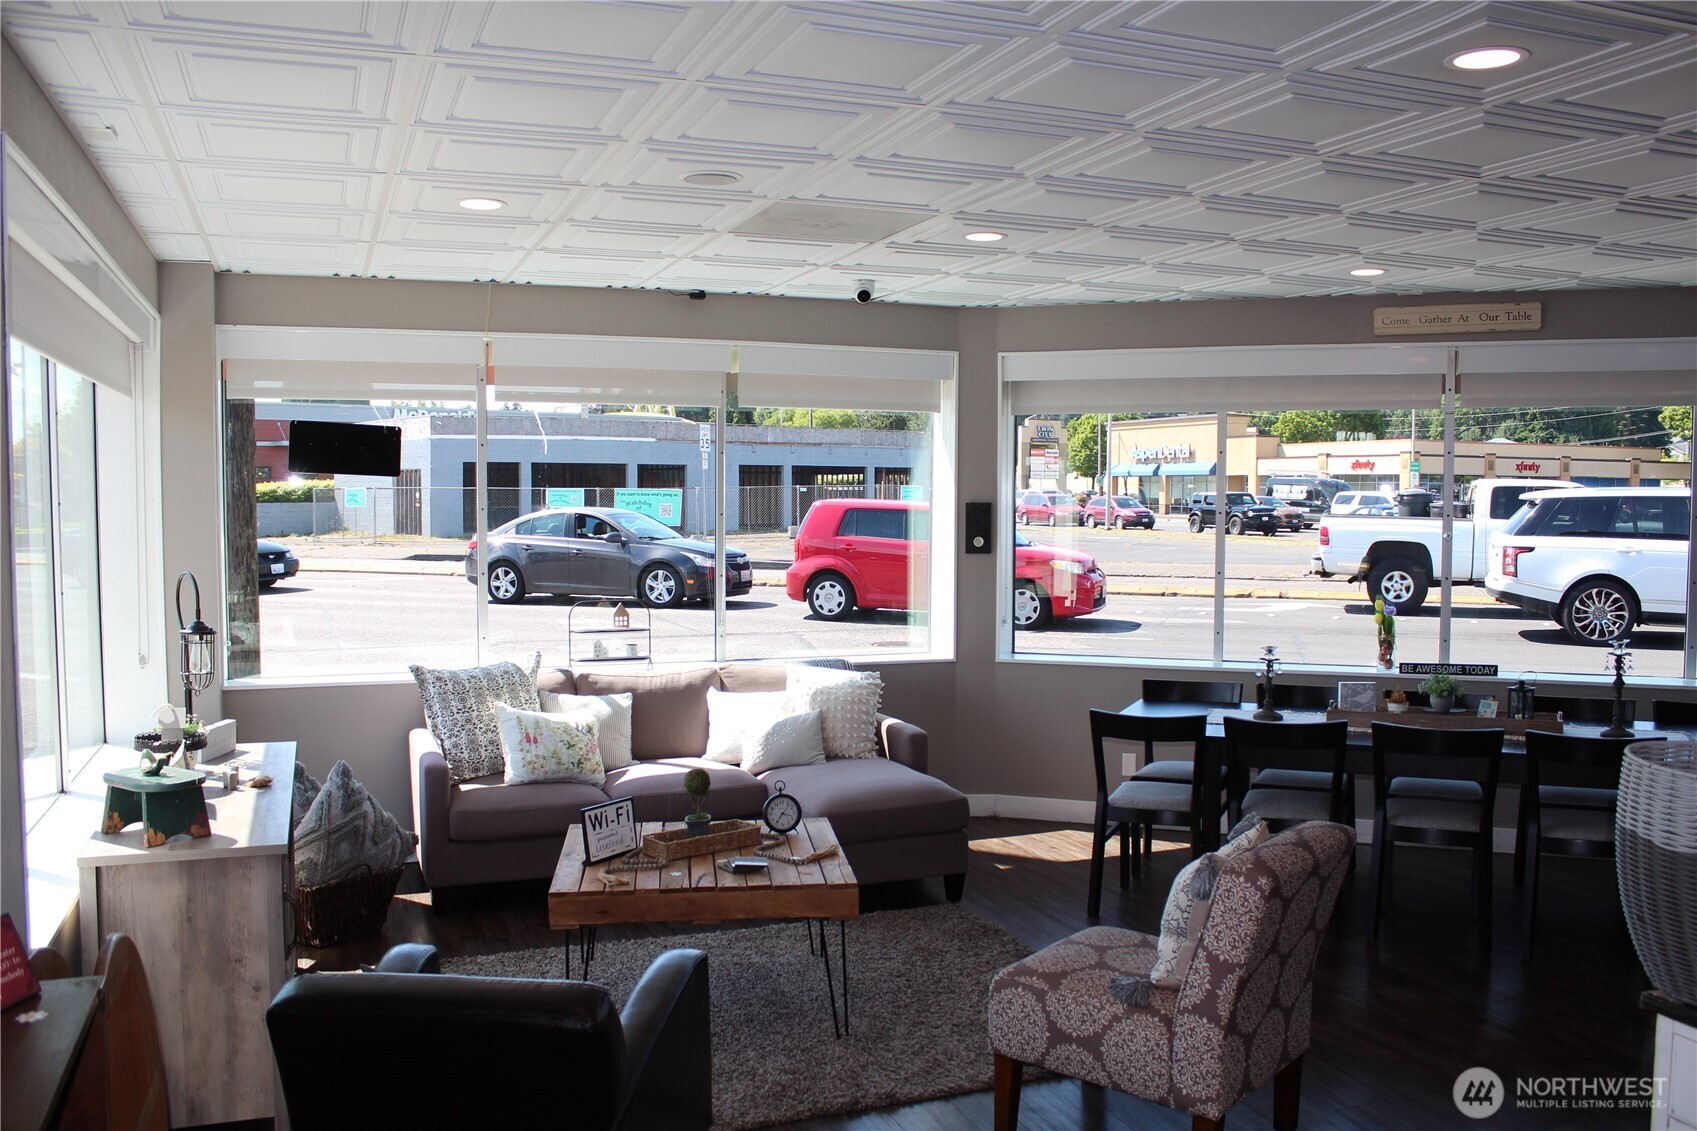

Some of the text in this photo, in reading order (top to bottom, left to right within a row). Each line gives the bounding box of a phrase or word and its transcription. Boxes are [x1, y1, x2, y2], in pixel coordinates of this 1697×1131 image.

[1382, 311, 1533, 326] Come Gather At Our Table
[700, 438, 710, 449] 35
[1515, 461, 1541, 473] xfinity
[625, 500, 652, 508] Watchdog
[1401, 664, 1496, 674] BE AWESOME TODAY
[588, 804, 630, 832] Wi-Fi
